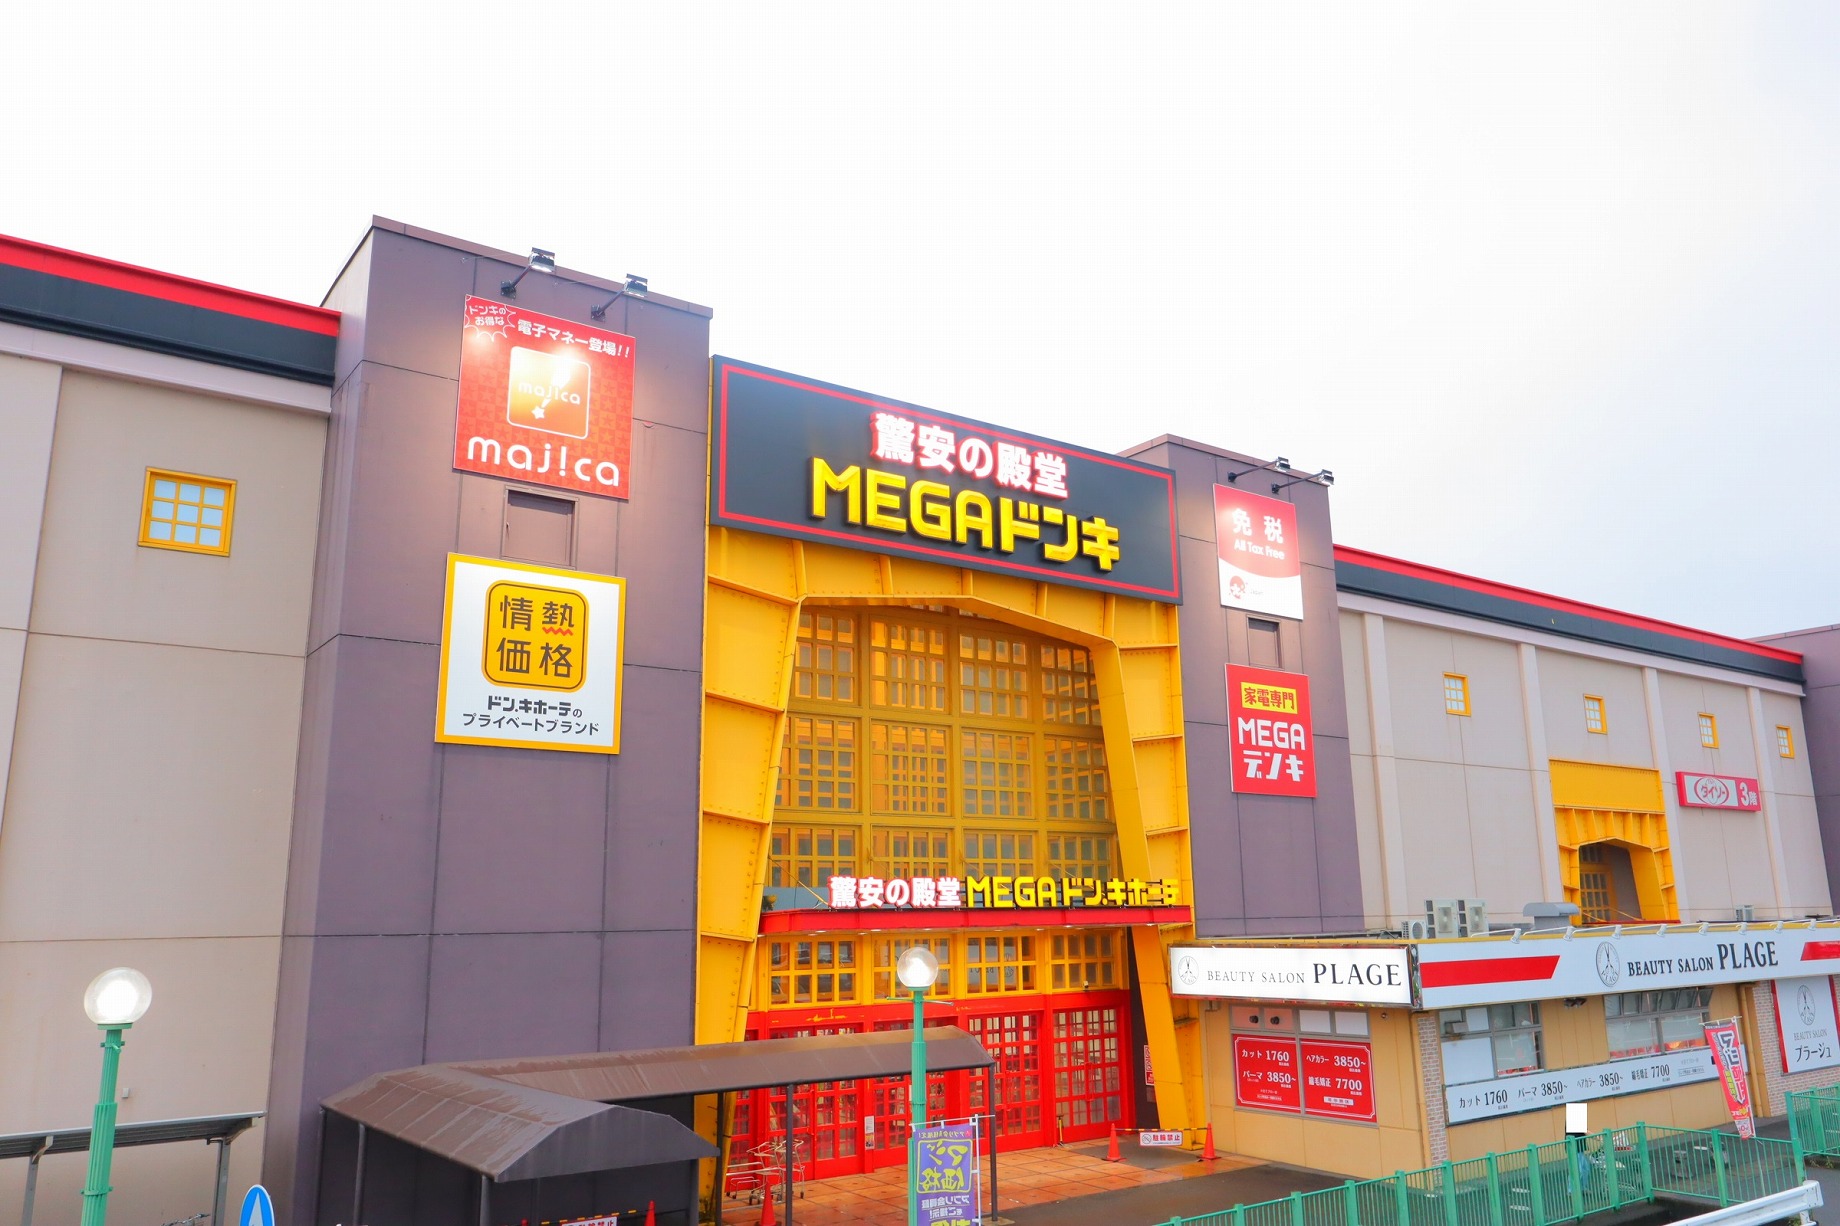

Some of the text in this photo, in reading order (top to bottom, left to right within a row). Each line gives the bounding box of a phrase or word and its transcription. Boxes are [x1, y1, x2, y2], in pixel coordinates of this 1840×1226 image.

[469, 305, 506, 315] ドンキの
[474, 316, 505, 326] お得な
[870, 412, 1069, 499] 驚安の殿堂
[811, 456, 1120, 572] MEGAドンキ
[1247, 542, 1264, 556] Tax
[1265, 546, 1285, 560] Free
[500, 595, 575, 634] 情熱
[496, 637, 573, 678] 価格
[1244, 687, 1295, 710] 家電専門
[462, 713, 599, 736] プライベートブランド
[1237, 717, 1306, 751] MEGA
[1243, 749, 1304, 782] デンキ
[828, 875, 962, 909] 驚安の殿堂
[1627, 941, 1779, 977] BEAUTY SALON PLAGE
[1207, 970, 1255, 982] BEAUTY
[1261, 971, 1305, 984] SALON
[1313, 963, 1402, 987] PLAGE
[1241, 1049, 1289, 1062] カット 1760
[1306, 1054, 1329, 1064] ヘアカラー
[1795, 1042, 1832, 1062] プラージュ
[1242, 1070, 1263, 1081] パーマ
[1335, 1077, 1362, 1091] 7700
[1459, 1095, 1480, 1108] カット
[1484, 1089, 1508, 1105] 1760
[1518, 1087, 1537, 1098] パーマ
[1651, 1064, 1670, 1078] 7700
